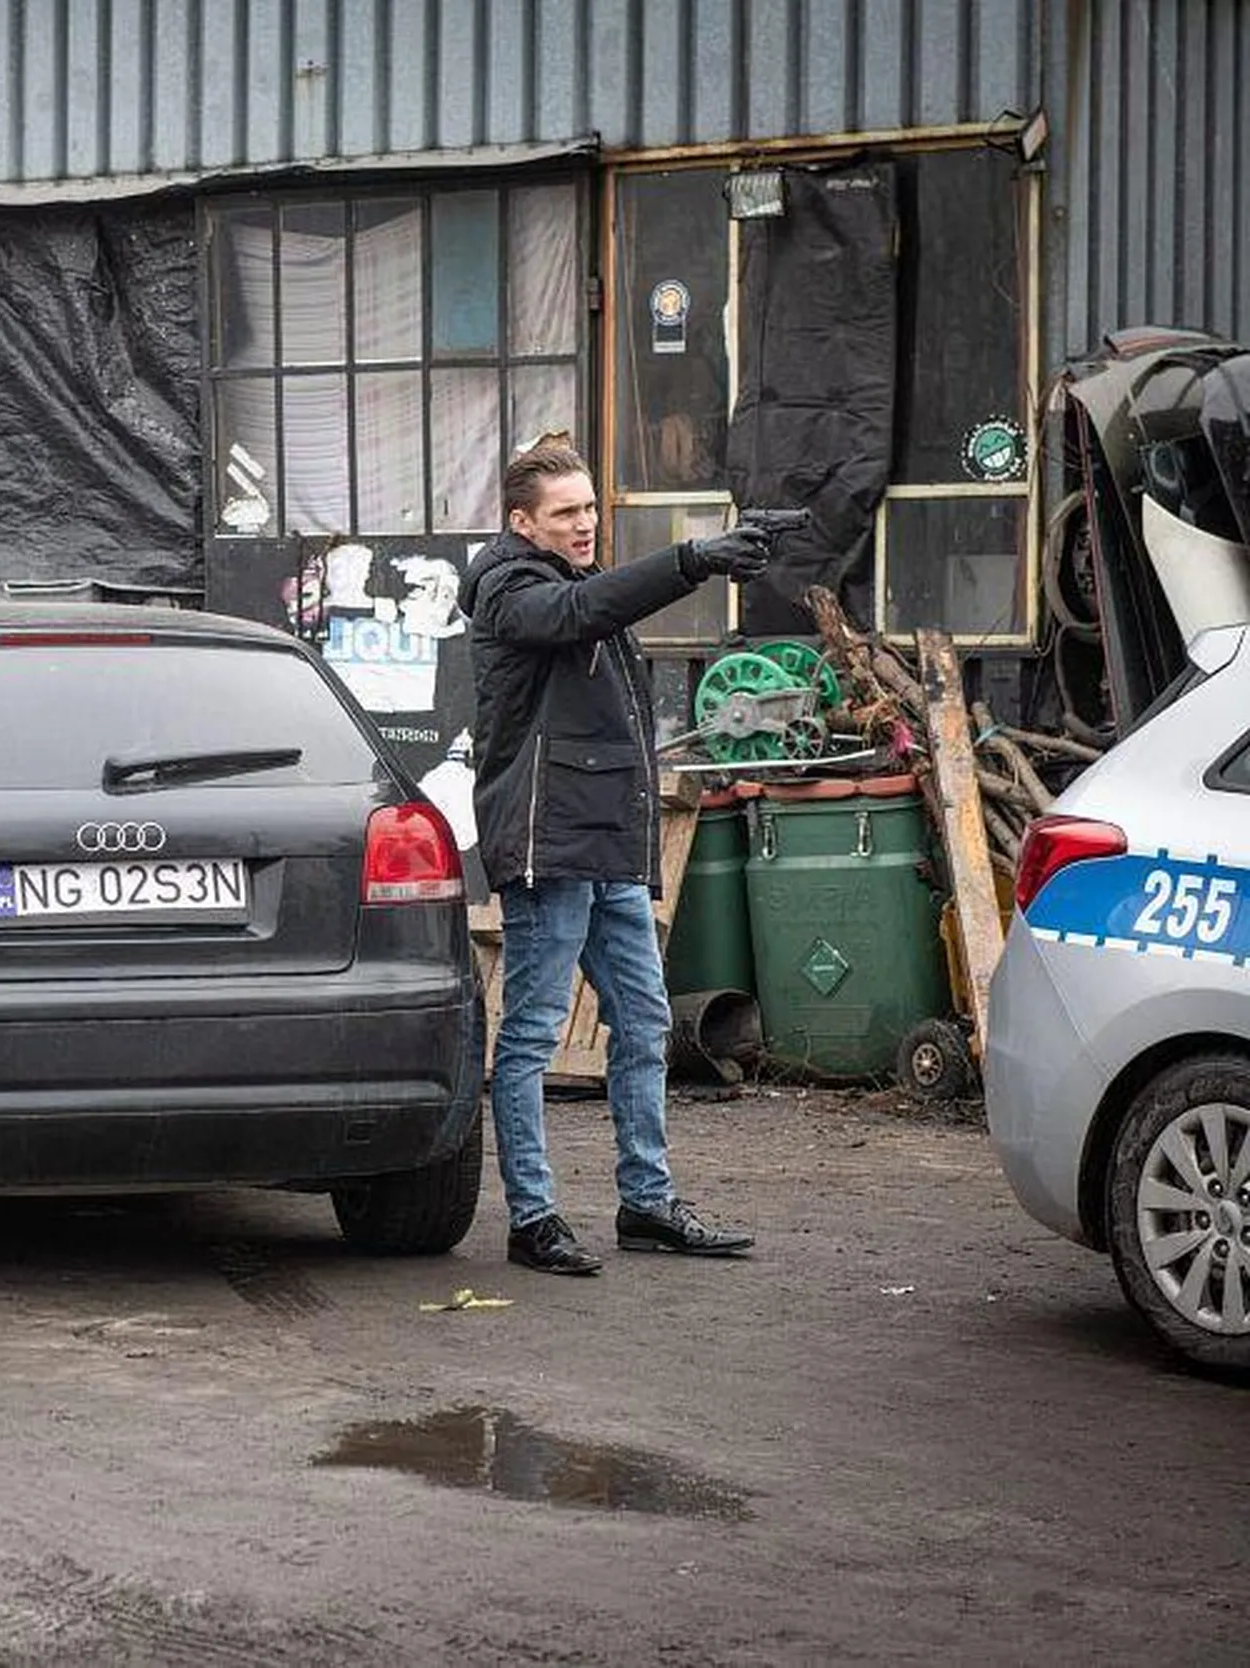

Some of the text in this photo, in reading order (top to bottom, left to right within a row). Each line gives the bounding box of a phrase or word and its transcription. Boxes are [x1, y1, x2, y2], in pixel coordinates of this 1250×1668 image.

[18, 862, 242, 910] NG 02S3N
[1133, 869, 1237, 944] 255
